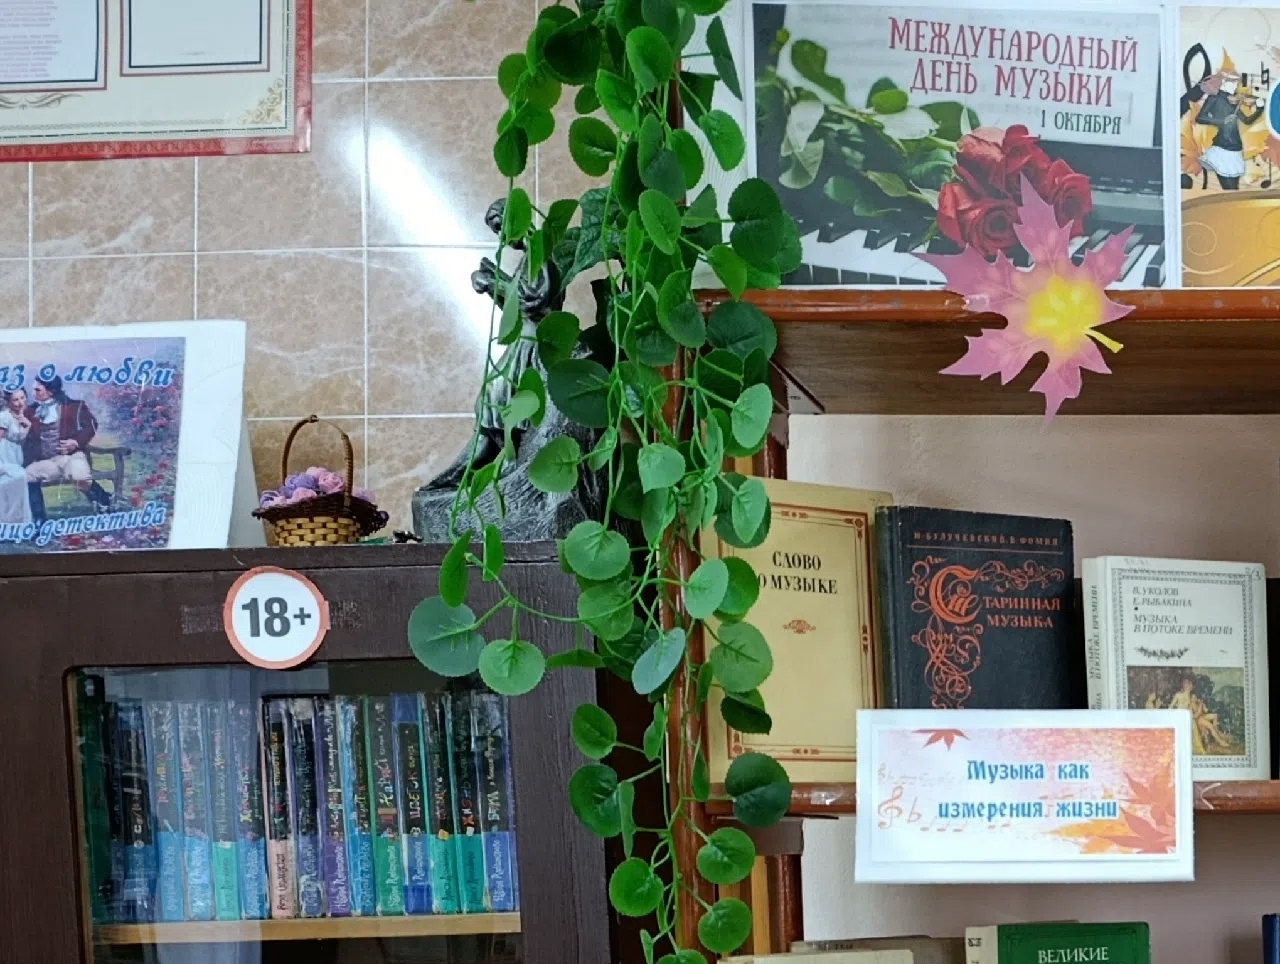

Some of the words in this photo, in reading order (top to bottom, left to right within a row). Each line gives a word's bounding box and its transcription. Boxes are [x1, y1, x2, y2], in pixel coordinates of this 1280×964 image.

[888, 16, 1138, 73] МЕЖДУНАРОДНЫЙ
[910, 59, 978, 96] ДЕНЬ
[994, 65, 1113, 108] МУЗЫКИ
[1040, 110, 1047, 129] 1
[1054, 112, 1122, 135] ОКТЯБРЯ
[39, 364, 55, 383] о
[64, 358, 174, 387] любви
[37, 501, 165, 546] детектива
[772, 551, 822, 571] СЛОВО
[770, 575, 838, 595] МУЗЫКЕ
[242, 598, 311, 638] 18+
[987, 615, 1053, 628] МУЗЫКА
[1133, 614, 1178, 624] МУЗЫКА
[1141, 625, 1184, 634] ПОТОКЕ
[1186, 626, 1233, 635] ВРЕМЕНИ
[967, 760, 1045, 784] Музыка
[1058, 763, 1089, 780] как
[938, 800, 1043, 821] измерения
[1056, 800, 1118, 818] жизни
[1038, 947, 1109, 964] ВЕЛИКИЕ
